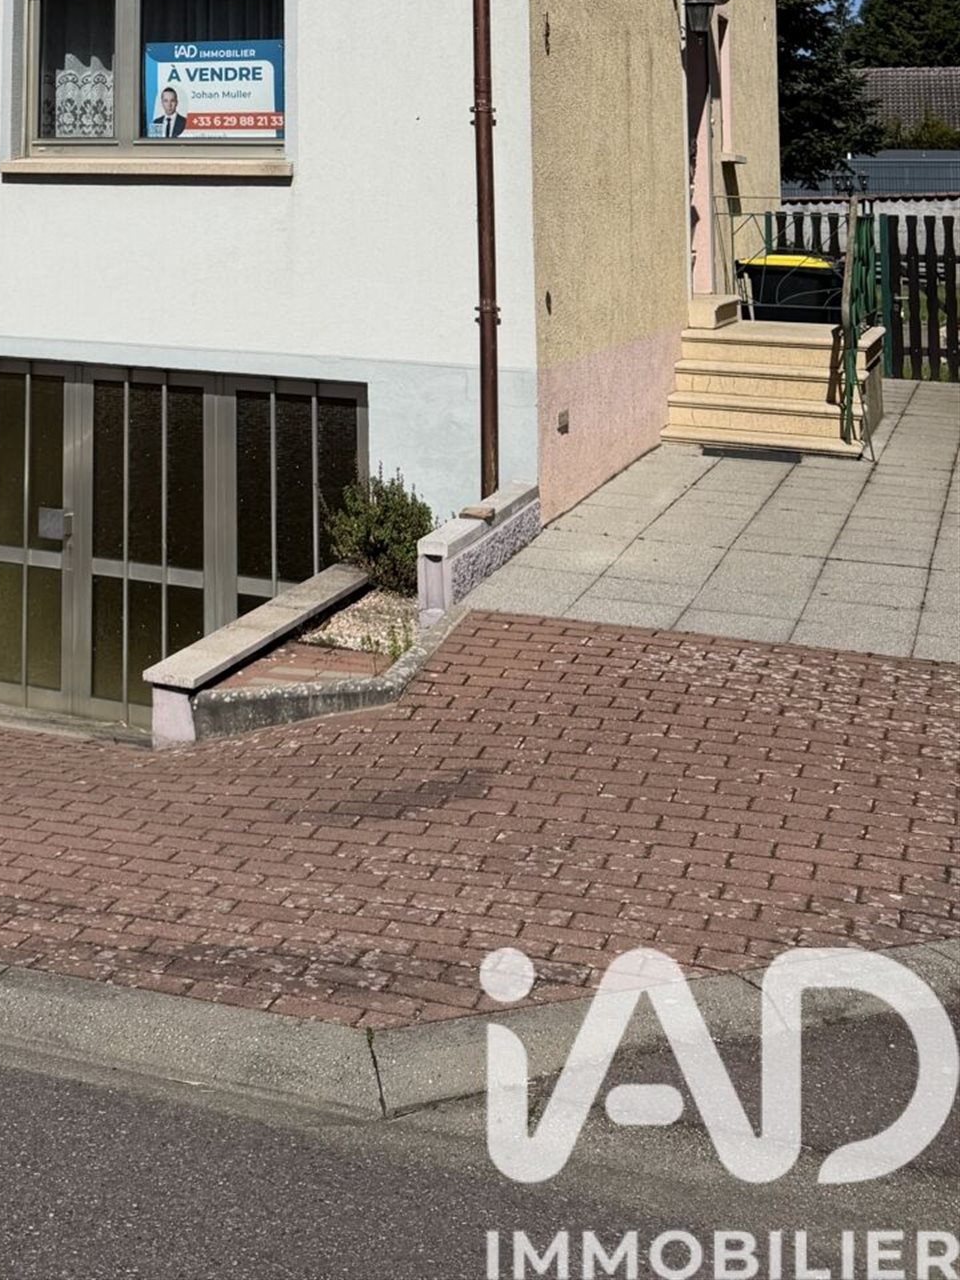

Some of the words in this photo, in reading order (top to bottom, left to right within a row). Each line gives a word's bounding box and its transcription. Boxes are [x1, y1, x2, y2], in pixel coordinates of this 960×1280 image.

[199, 49, 256, 58] IMMOBILIER
[167, 64, 181, 82] À
[185, 67, 263, 82] VENDRE
[191, 90, 219, 100] Johan
[222, 90, 252, 99] Muller
[192, 116, 211, 126] +33
[213, 116, 222, 126] 6
[223, 116, 237, 126] 29
[239, 116, 254, 126] 88
[257, 116, 268, 126] 21
[270, 116, 284, 126] 33
